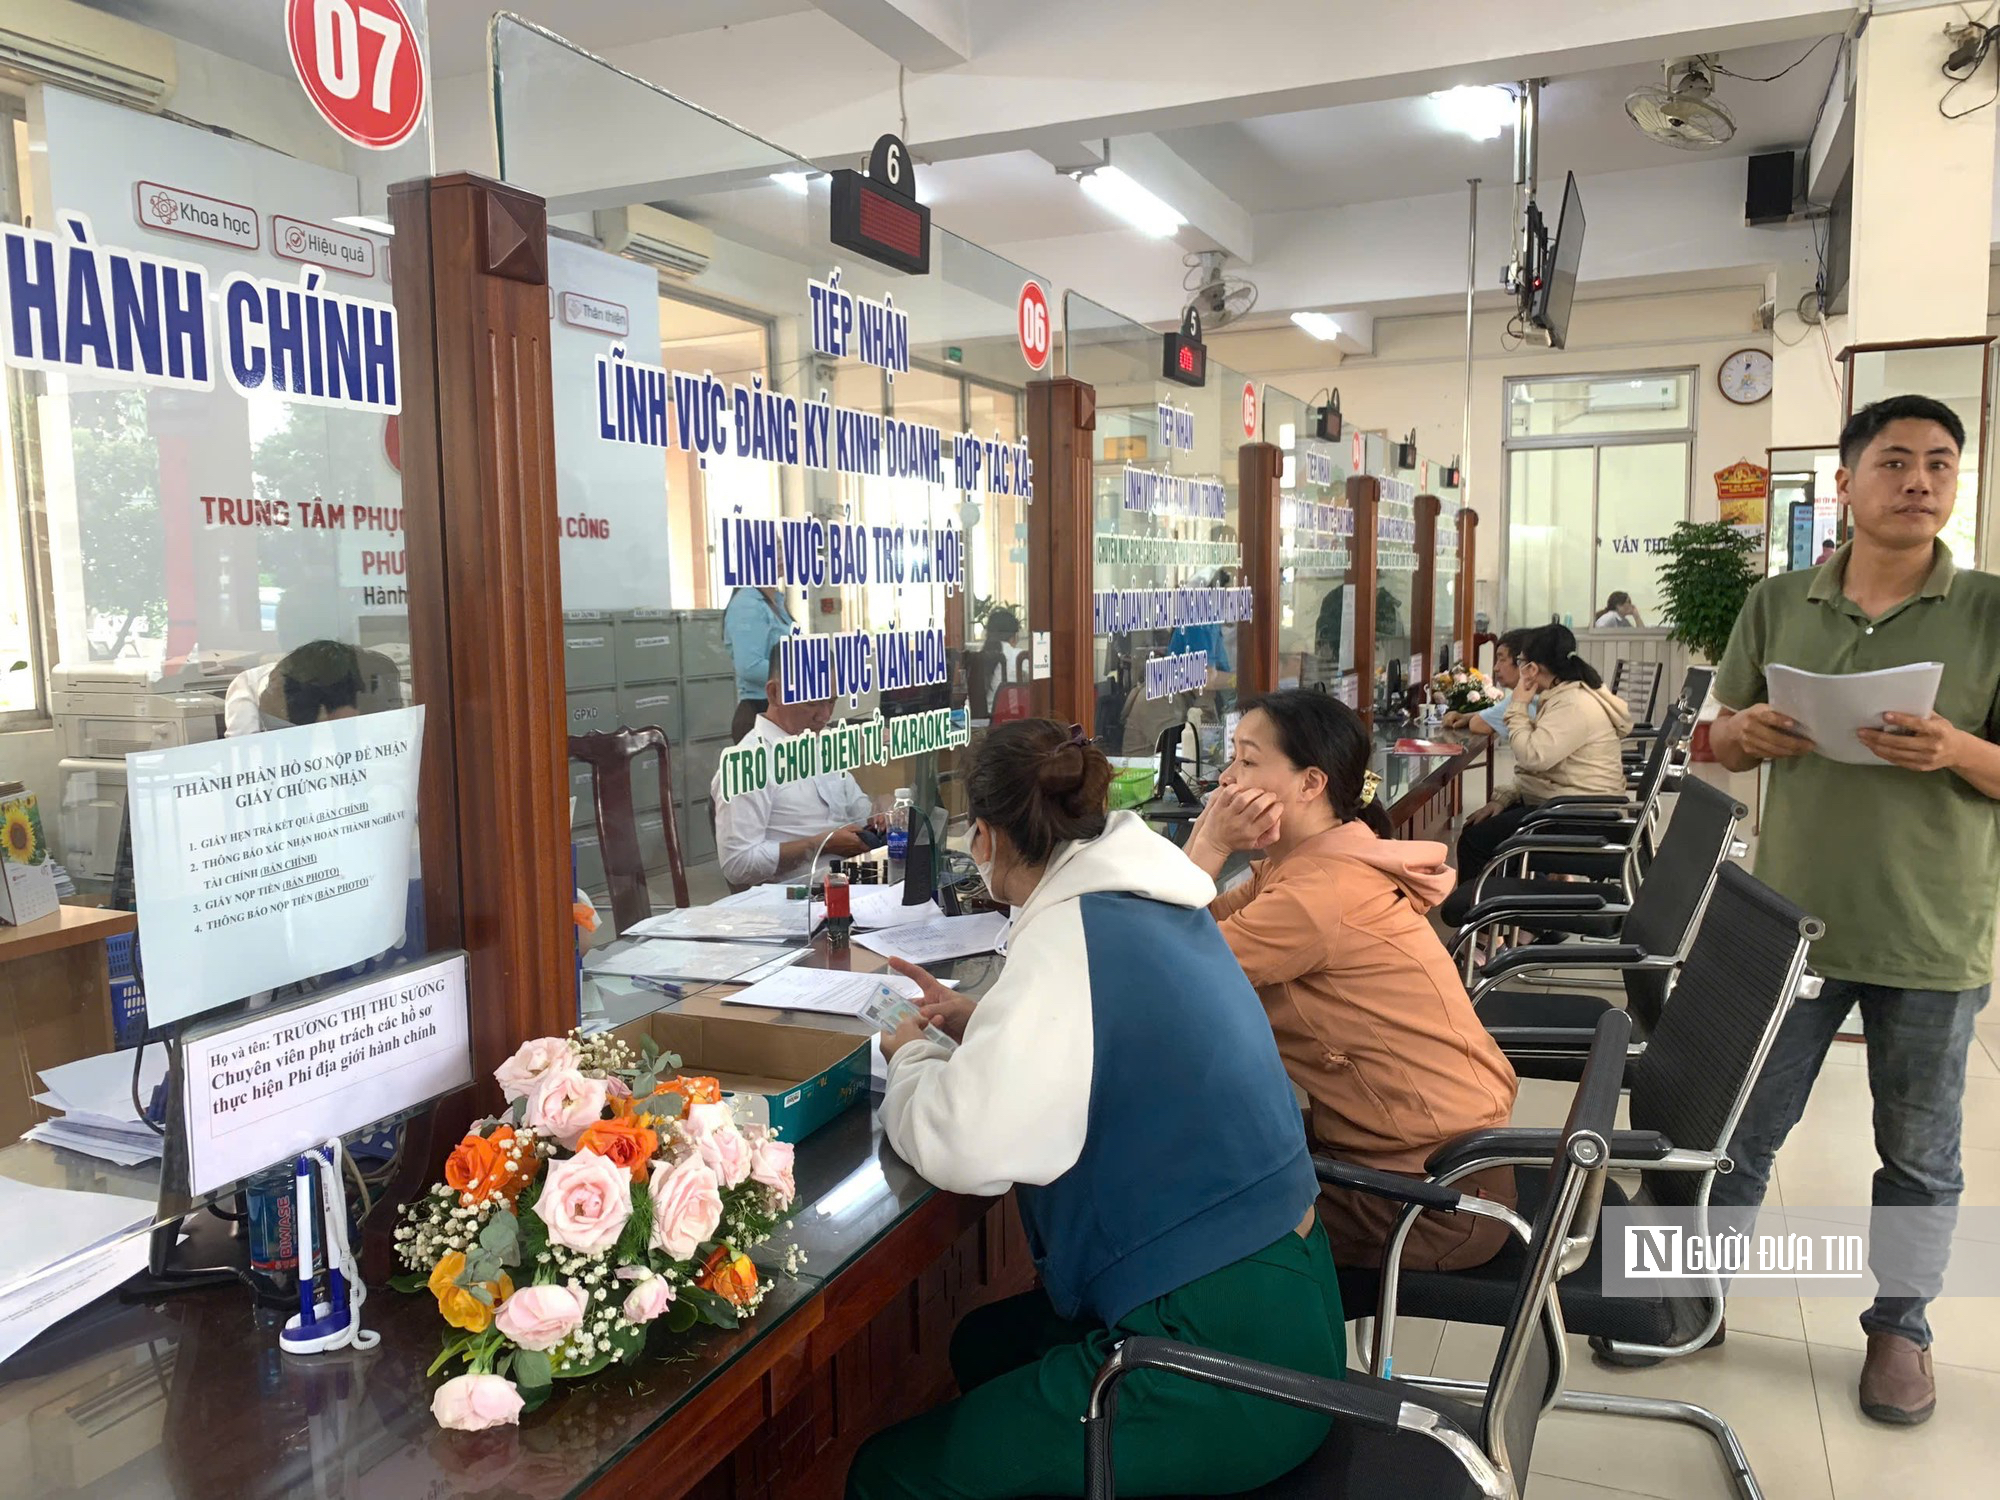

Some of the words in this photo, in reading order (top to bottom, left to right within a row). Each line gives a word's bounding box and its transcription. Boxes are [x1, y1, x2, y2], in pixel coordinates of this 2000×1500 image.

[313, 0, 402, 114] 07
[886, 144, 900, 185] 6
[180, 202, 218, 227] Khoa
[223, 213, 250, 236] học
[309, 233, 337, 256] Hiệu
[341, 245, 364, 263] quả
[5, 219, 209, 382] HÀNH
[229, 273, 397, 406] CHÍNH
[809, 272, 851, 357] TIẾP
[858, 297, 909, 384] NHẬN
[1023, 297, 1046, 353] 06
[1190, 311, 1197, 337] 5
[597, 346, 668, 448] LĨNH
[674, 374, 727, 470] VỰC
[734, 376, 798, 465] ĐĂNG
[804, 392, 830, 470] KÝ
[836, 408, 881, 476] KINH
[885, 419, 945, 492] DOANH,
[954, 433, 982, 502] HỢP
[985, 432, 1010, 495] TÁC
[1243, 394, 1255, 428] 05
[200, 497, 290, 527] TRUNG
[297, 497, 345, 529] TÂM
[566, 516, 610, 540] CÔNG
[1612, 535, 1639, 553] VĂN
[362, 550, 406, 576] PHƯ
[722, 504, 775, 586] LĨNH
[782, 516, 824, 600] VỰC
[829, 503, 867, 585] BẢO
[872, 523, 905, 596] TRỢ
[782, 625, 830, 704] LĨNH
[835, 628, 871, 708] VỰC
[876, 620, 910, 691] VĂN
[914, 617, 947, 685] HÓA
[173, 775, 233, 799] THÀNH
[304, 756, 323, 774] SƠ
[325, 751, 352, 773] NỘP
[374, 740, 408, 760] NHẬN
[723, 737, 767, 801] (TRÒ
[774, 733, 816, 785] CHƠI
[821, 724, 860, 779] ĐIỆN
[863, 712, 887, 766] TỬ,
[235, 788, 274, 809] GIẤY
[276, 776, 328, 801] CHỨNG
[329, 768, 368, 789] NHẬN
[189, 842, 197, 852] 1.
[200, 835, 228, 850] GIẤY
[230, 829, 251, 845] HẸN
[252, 823, 273, 838] TRẢ
[275, 818, 294, 833] KẾT
[295, 812, 315, 829] QUẢ
[337, 801, 369, 820] CHÍNH)
[190, 862, 199, 873] 2.
[201, 851, 241, 871] THÔNG
[242, 846, 264, 860] BÁO
[265, 840, 286, 855] XÁC
[287, 831, 313, 850] NHẬN
[340, 820, 371, 838] THÀNH
[371, 811, 398, 828] NGHĨA
[193, 903, 202, 914] 3.
[204, 894, 233, 911] GIẤY
[234, 888, 256, 905] NỘP
[282, 875, 304, 892] (BẢN
[305, 867, 340, 886] PHOTO)
[203, 874, 223, 890] TÀI
[224, 868, 259, 886] CHÍNH
[260, 862, 284, 879] (BẢN
[284, 853, 318, 872] CHÍNH)
[194, 924, 203, 934] 4.
[205, 910, 246, 932] THÔNG
[246, 905, 268, 921] BÁO
[269, 900, 290, 916] NỘP
[314, 887, 337, 903] (BẢN
[336, 877, 369, 897] PHOTO)
[210, 1053, 228, 1068] Họ
[231, 1045, 246, 1060] và
[247, 1039, 271, 1056] tên:
[272, 1013, 339, 1047] TRƯƠNG
[340, 1003, 367, 1025] THỊ
[368, 993, 399, 1015] THU
[400, 978, 446, 1005] SƯƠNG
[211, 1060, 271, 1091] Chuyên
[276, 1047, 306, 1068] viên
[309, 1037, 336, 1062] phụ
[339, 1023, 374, 1045] trách
[377, 1016, 399, 1036] các
[400, 1004, 418, 1025] hồ
[418, 1004, 434, 1018] sơ
[212, 1090, 248, 1115] thực
[252, 1077, 284, 1101] hiện
[288, 1065, 313, 1088] Phi
[315, 1056, 338, 1079] địa
[340, 1046, 367, 1072] giới
[368, 1034, 401, 1056] hành
[403, 1022, 437, 1045] chính
[277, 1195, 292, 1258] BIWASE
